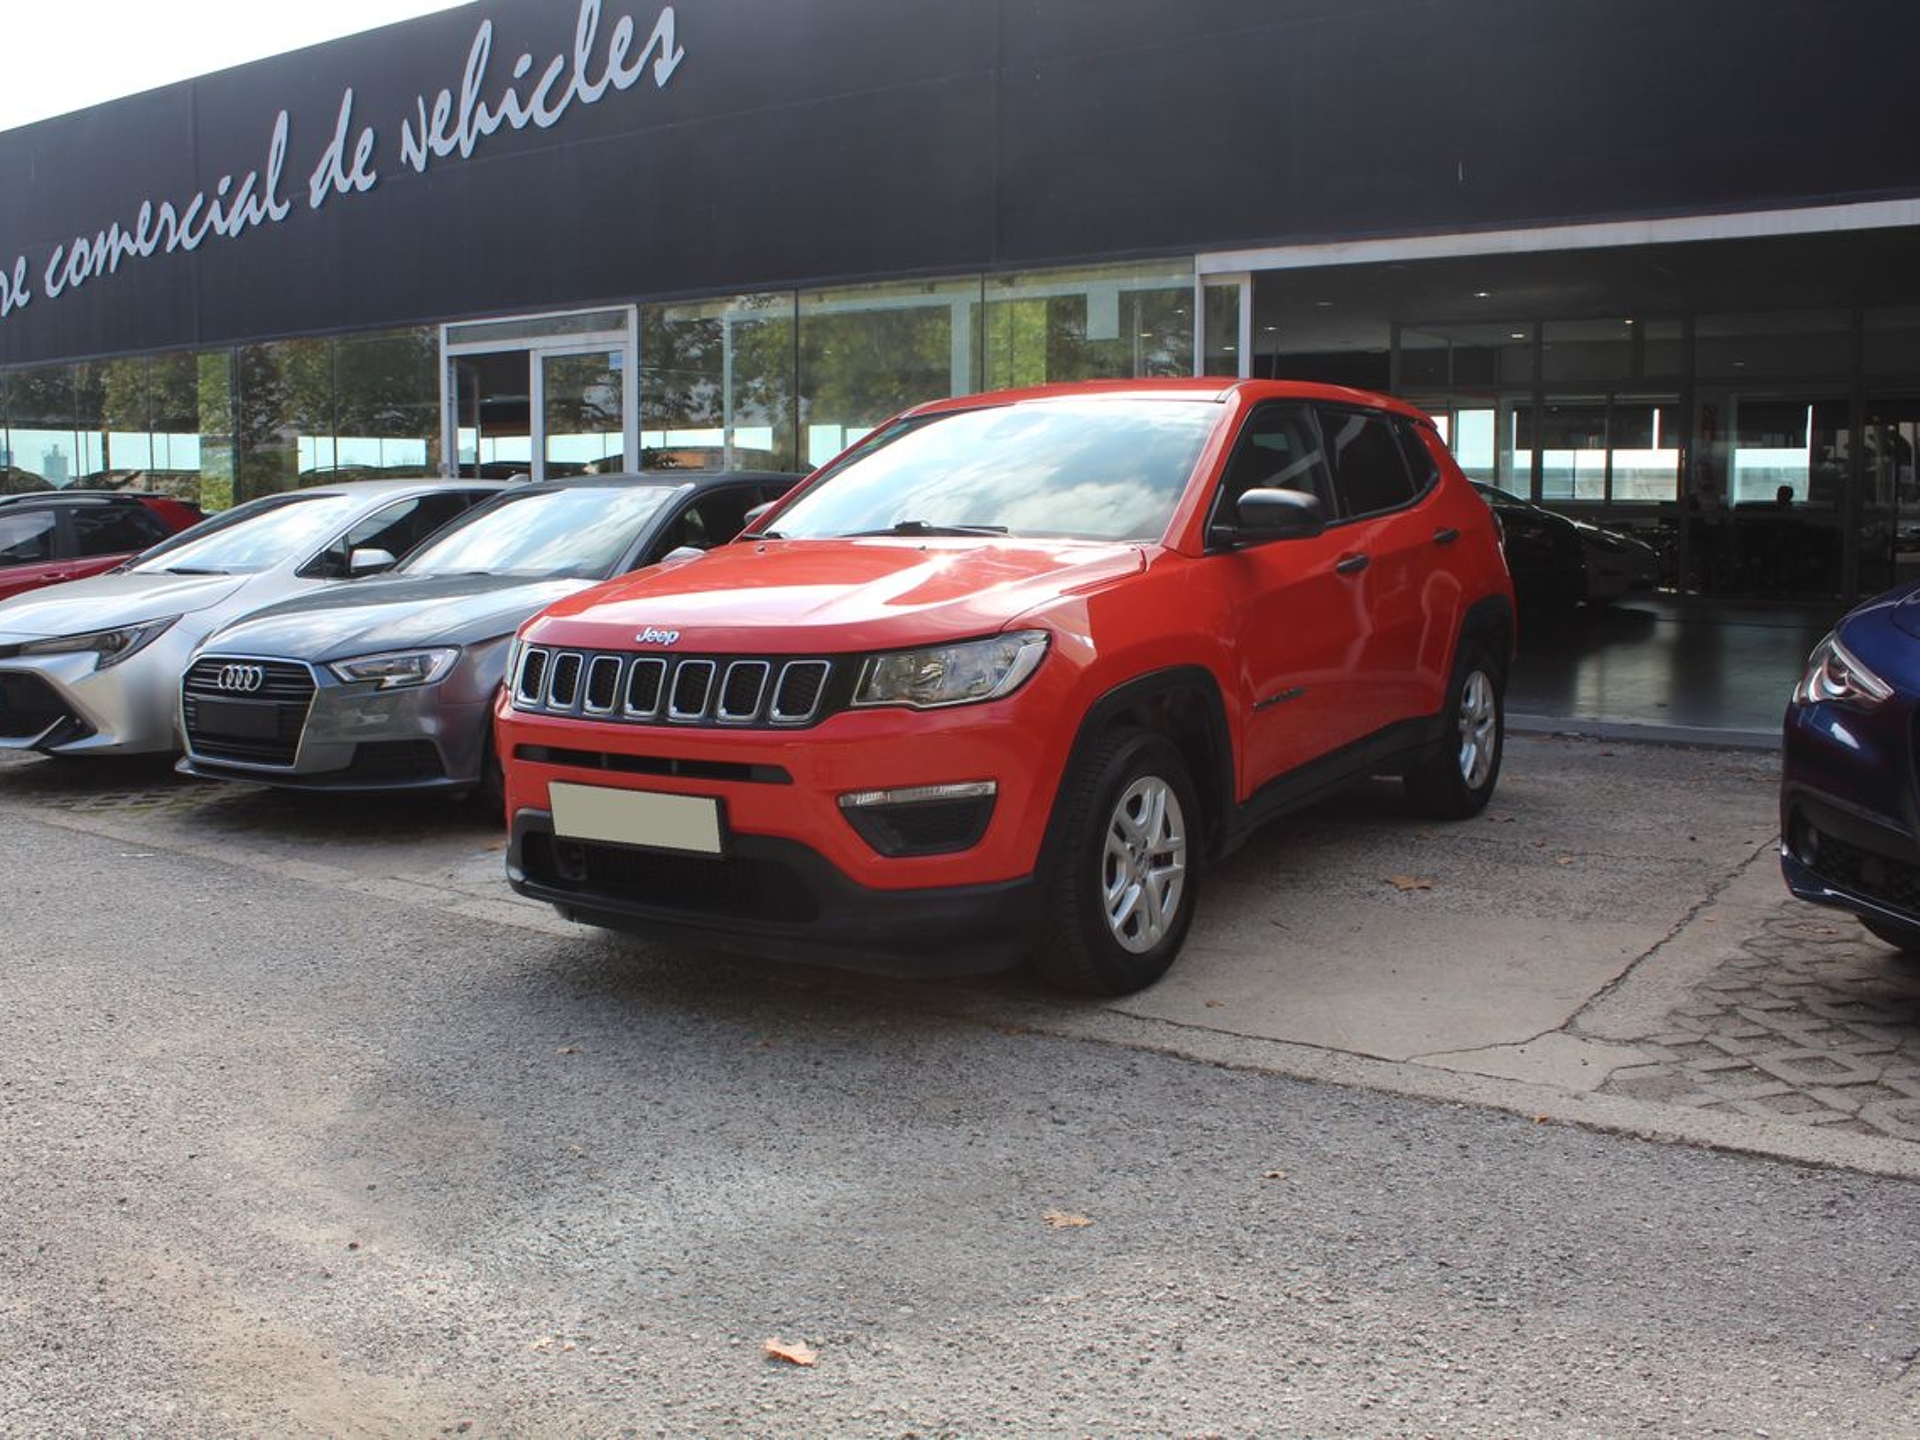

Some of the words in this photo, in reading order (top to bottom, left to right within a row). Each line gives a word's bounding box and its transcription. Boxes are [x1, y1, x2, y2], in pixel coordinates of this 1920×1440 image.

[44, 109, 290, 298] comercial
[309, 87, 377, 209] de
[400, 0, 685, 173] vehicles
[635, 626, 680, 646] Jeep
